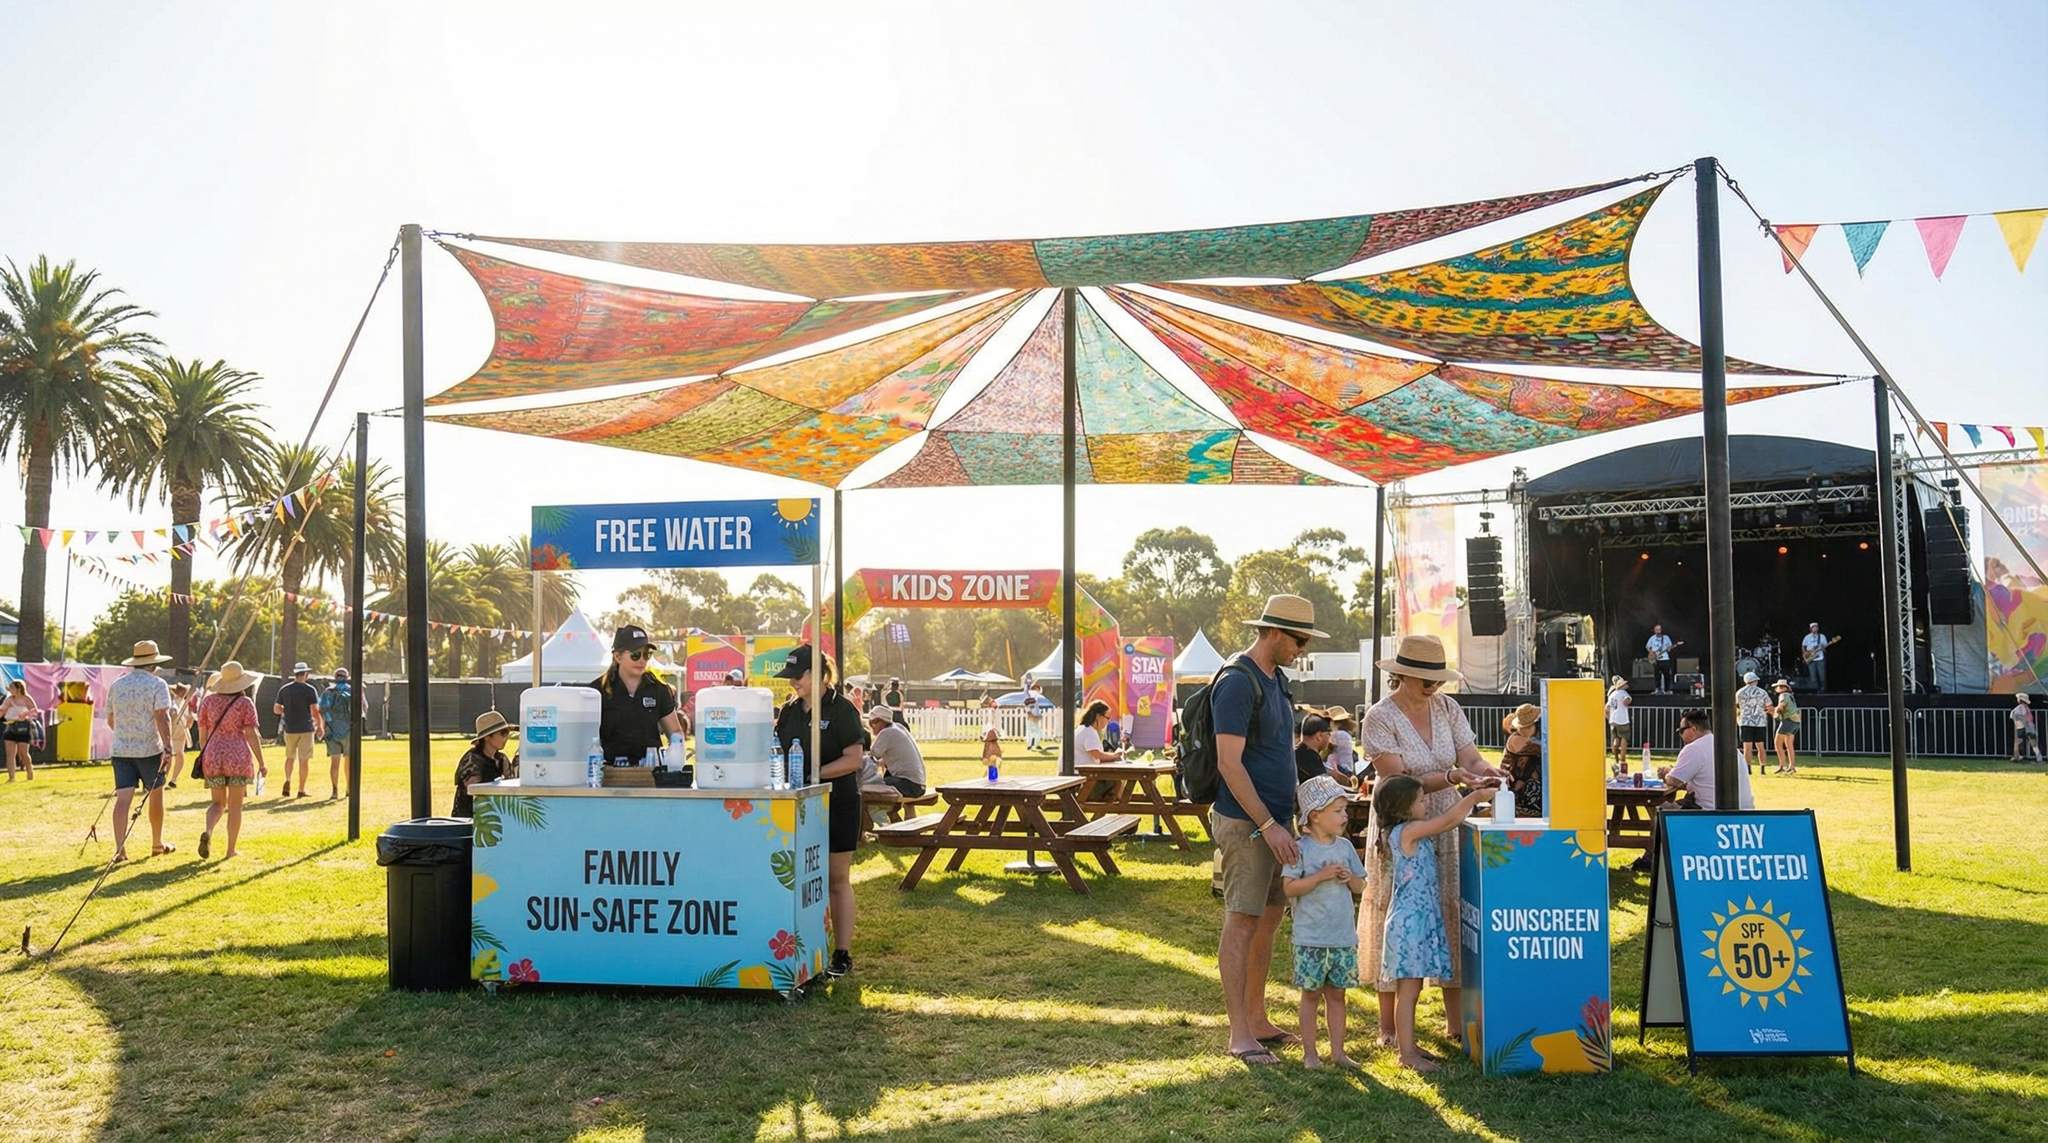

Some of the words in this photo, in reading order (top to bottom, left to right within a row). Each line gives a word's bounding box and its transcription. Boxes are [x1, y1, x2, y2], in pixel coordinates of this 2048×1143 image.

[595, 518, 657, 553] FREE
[664, 516, 752, 551] WATER
[891, 574, 954, 601] KIDS
[961, 574, 1031, 601] ZONE
[1131, 656, 1167, 673] STAY
[1716, 823, 1765, 849] STAY
[584, 849, 681, 886] FAMILY
[805, 844, 820, 873] FREE
[1682, 854, 1809, 881] PROTECTED!
[801, 876, 823, 909] WATER
[526, 895, 659, 934] SUN-SAFE
[666, 899, 738, 936] ZONE
[1491, 908, 1600, 932] SUNSCREEN
[1741, 922, 1765, 939] SPF
[1508, 936, 1583, 960] STATION
[1734, 943, 1791, 980] 50+
